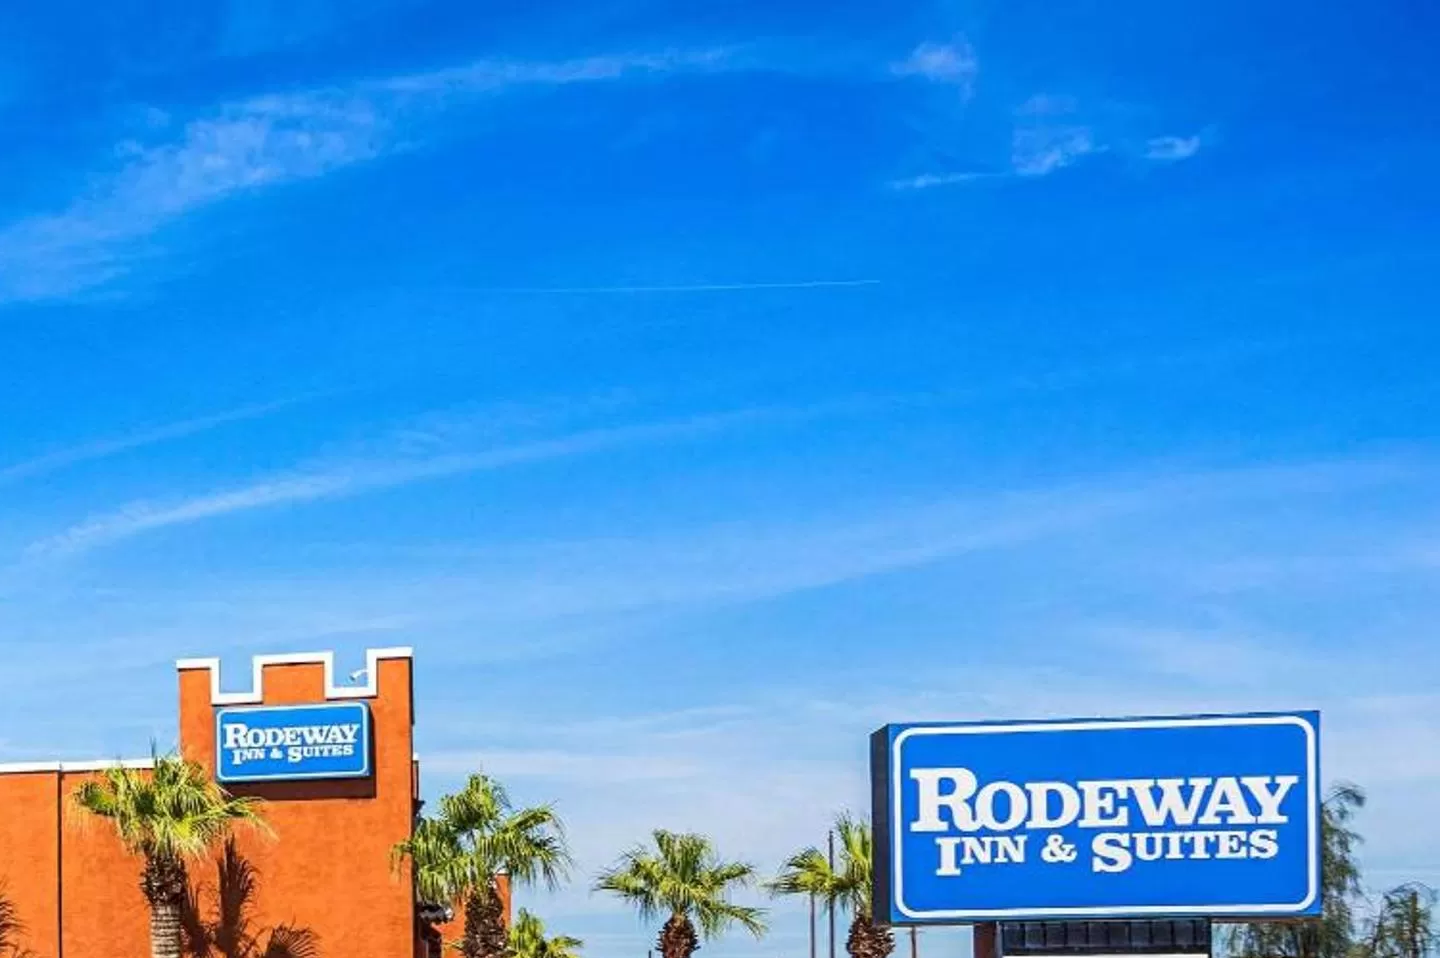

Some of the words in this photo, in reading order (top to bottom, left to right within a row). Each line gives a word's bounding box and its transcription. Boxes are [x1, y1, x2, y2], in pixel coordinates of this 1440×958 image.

[223, 723, 360, 748] RODEWAY
[232, 748, 265, 765] INN
[270, 747, 283, 759] &
[287, 744, 354, 764] SUITES
[910, 767, 1298, 832] RODEWAY
[936, 835, 1027, 876] INN
[1040, 834, 1077, 863] &
[1091, 829, 1279, 873] SUITES
